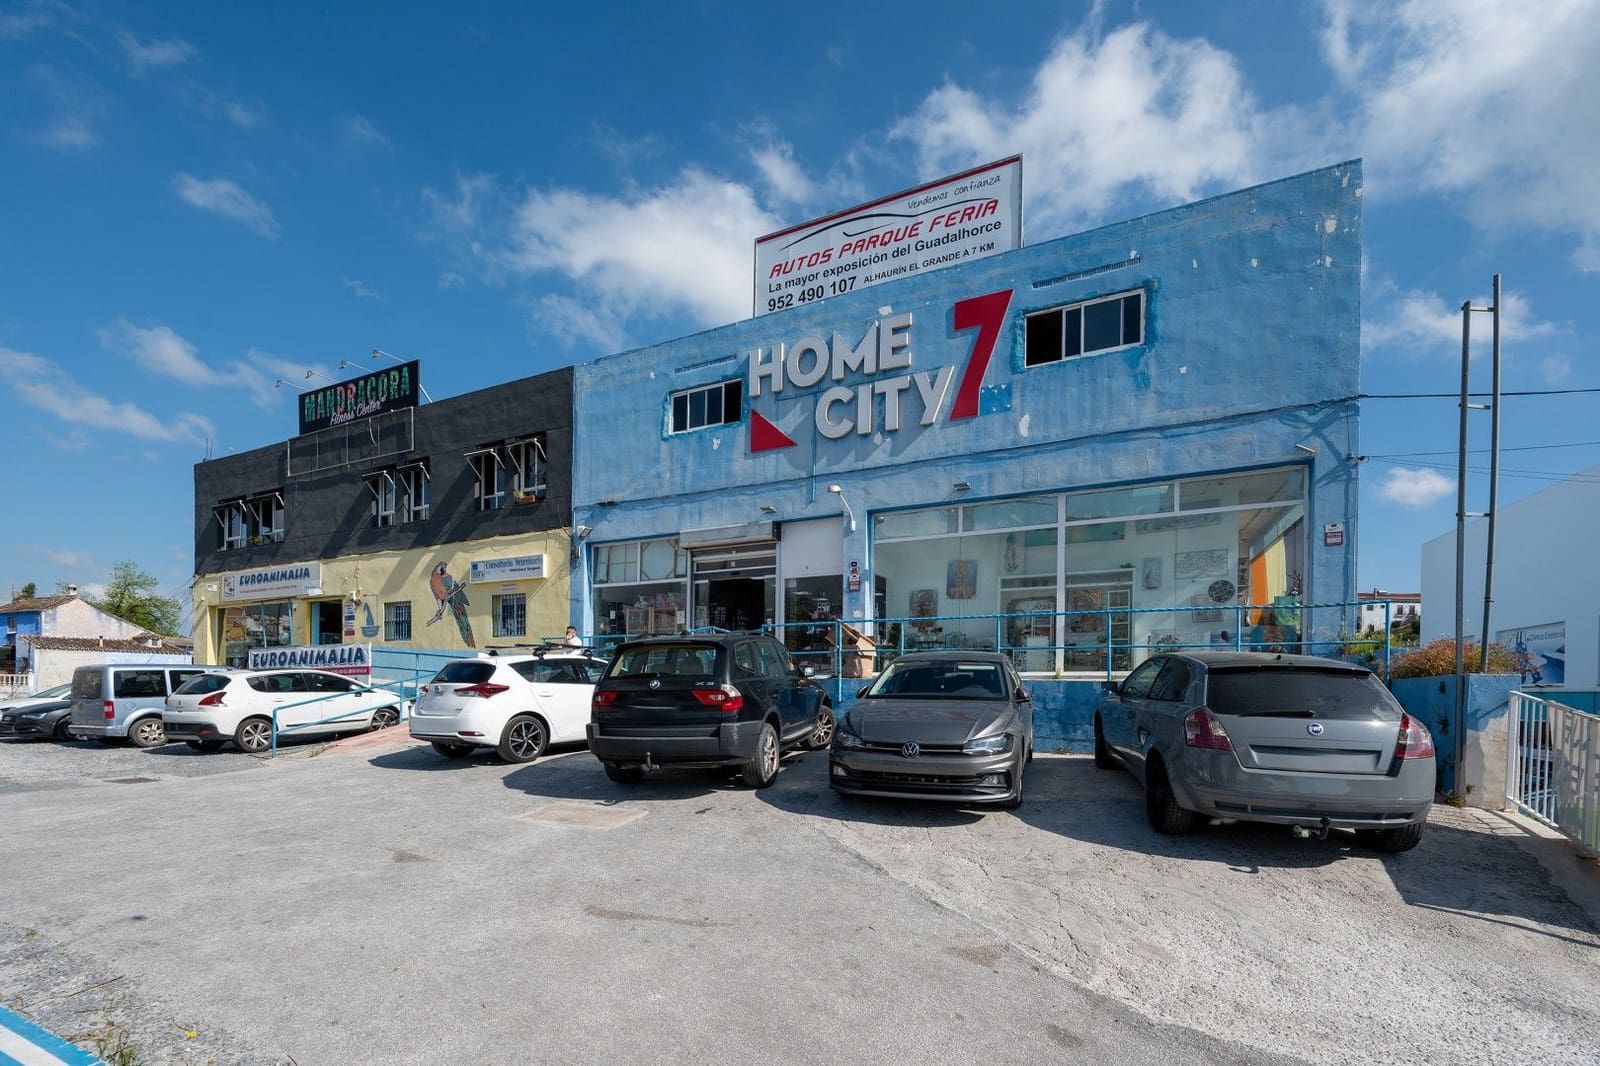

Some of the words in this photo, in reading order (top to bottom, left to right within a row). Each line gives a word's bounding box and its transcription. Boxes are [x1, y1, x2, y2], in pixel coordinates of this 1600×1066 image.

[907, 191, 949, 209] Vendemos
[953, 175, 1001, 196] confianza
[768, 283, 782, 293] La
[784, 271, 821, 290] mayor
[823, 251, 888, 280] exposición
[891, 245, 911, 260] del
[914, 220, 1002, 253] Guadalhorce
[769, 249, 832, 279] AUTOS
[838, 220, 923, 258] PARQUE
[928, 199, 999, 233] FERIA
[863, 265, 907, 284] ALHAURÍN
[909, 261, 921, 271] EL
[922, 251, 961, 269] GRANDE
[971, 246, 978, 255] 7
[979, 242, 995, 253] KM
[767, 293, 794, 312] 952
[798, 284, 825, 304] 490
[829, 276, 857, 295] 107
[748, 312, 913, 398] HOME
[949, 288, 1015, 421] 7
[304, 366, 410, 423] MANDRAGORA
[329, 406, 356, 426] Fitness
[356, 400, 383, 418] Center
[815, 365, 955, 440] CITY
[239, 567, 311, 587] EUROANIMALIA
[252, 647, 366, 668] EUROANIMALIA
